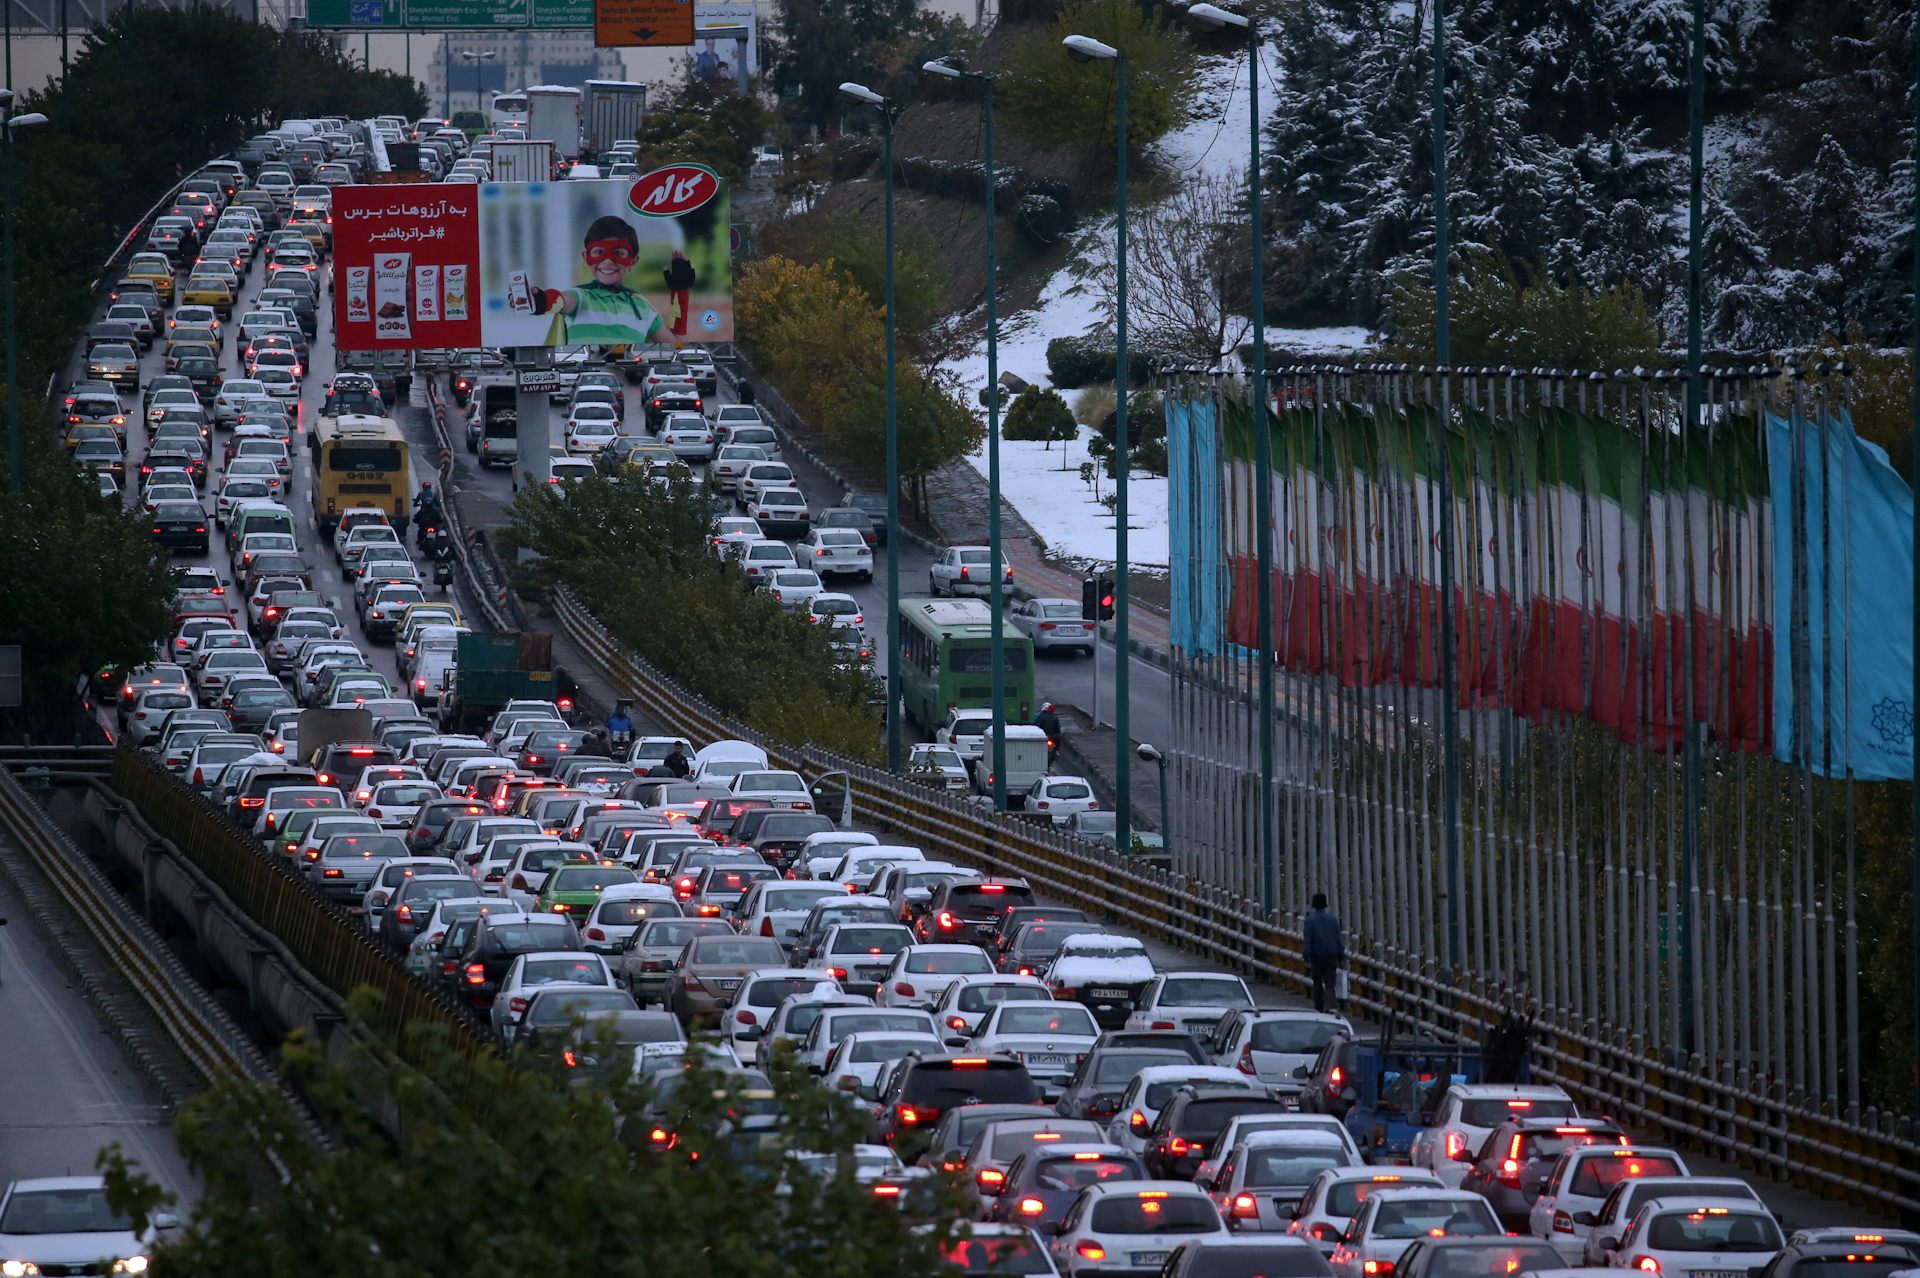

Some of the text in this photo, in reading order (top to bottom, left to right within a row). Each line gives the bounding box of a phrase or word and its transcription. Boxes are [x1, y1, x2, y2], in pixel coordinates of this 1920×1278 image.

[352, 16, 370, 24] Karaj
[344, 200, 467, 220] به آرزوهات برس
